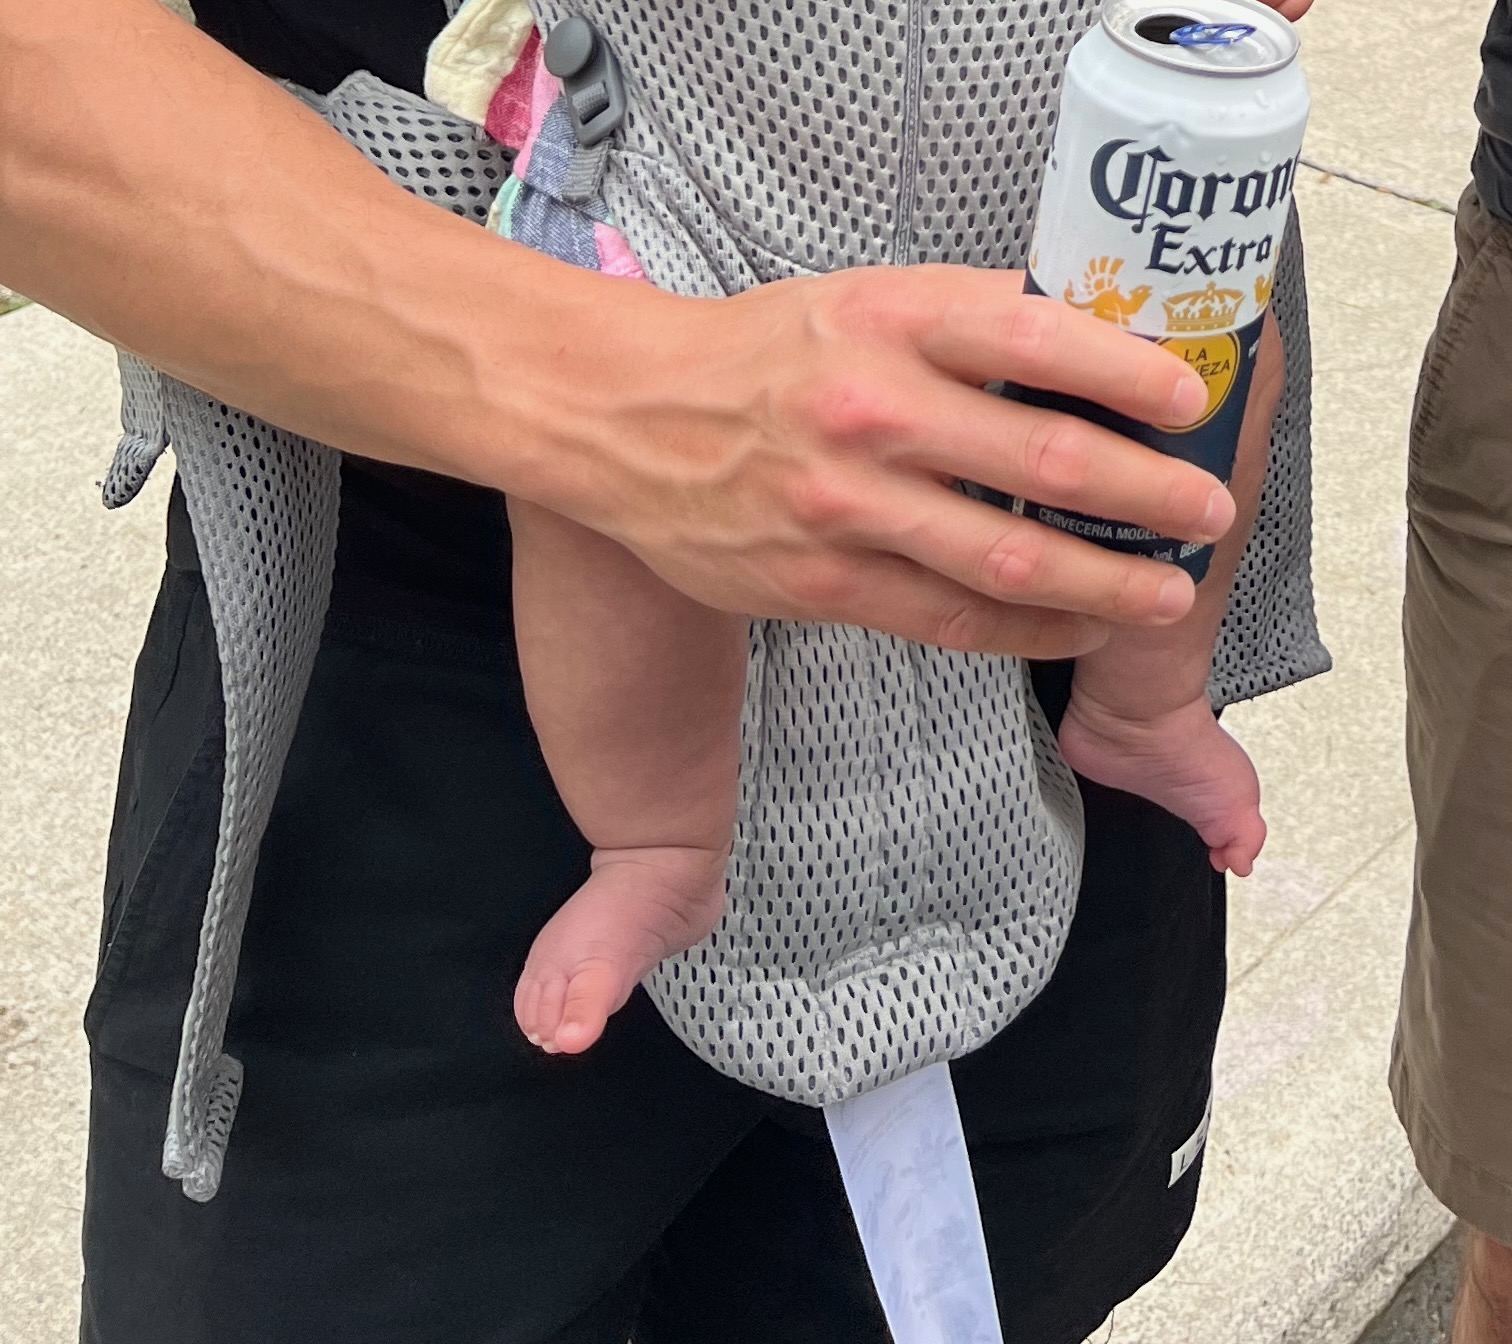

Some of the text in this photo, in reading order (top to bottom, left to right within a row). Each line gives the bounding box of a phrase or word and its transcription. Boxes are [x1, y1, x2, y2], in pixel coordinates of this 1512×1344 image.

[1090, 138, 1298, 234] Coron
[1145, 222, 1273, 275] Extra
[1183, 347, 1207, 363] LA
